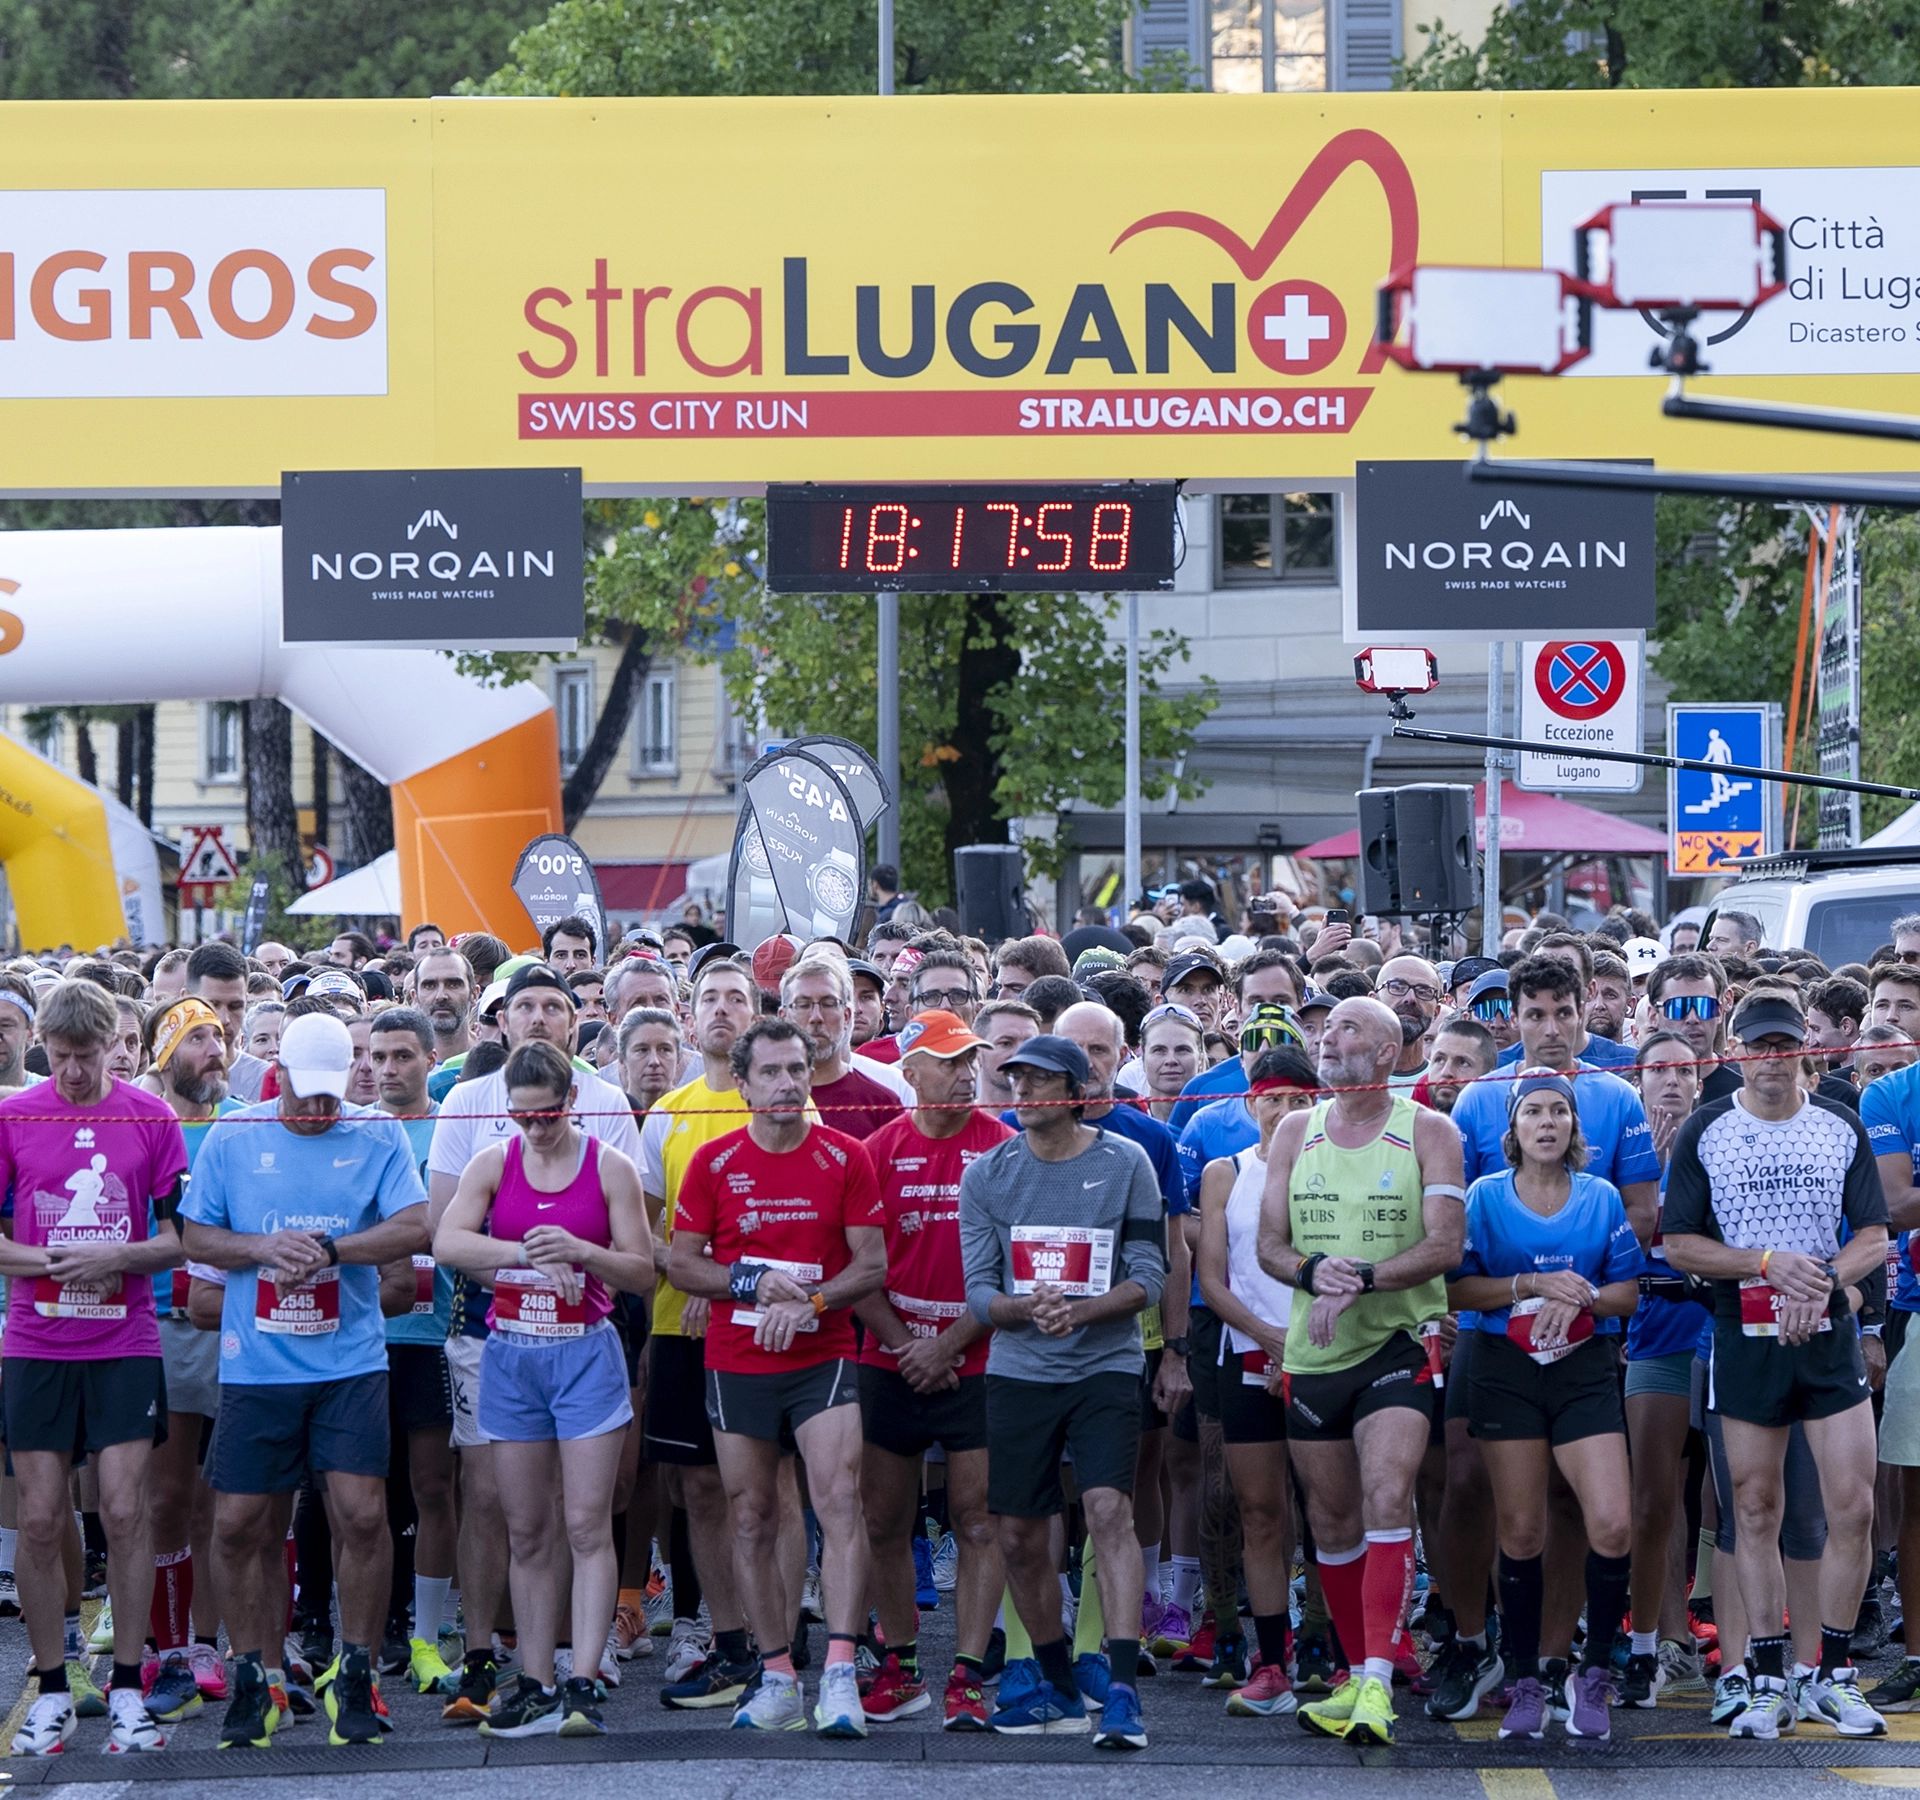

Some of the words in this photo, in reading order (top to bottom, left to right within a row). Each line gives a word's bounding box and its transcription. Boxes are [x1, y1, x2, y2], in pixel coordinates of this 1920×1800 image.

[1789, 215, 1884, 250] Città
[0, 248, 377, 341] IGROS
[1789, 265, 1824, 300] di
[1842, 267, 1920, 309] Luga
[1790, 322, 1906, 343] Dicastero
[529, 401, 637, 431] SWISS
[650, 400, 723, 431] CITY
[736, 400, 808, 430] RUN
[1019, 396, 1345, 428] STRALUGANO.CH
[840, 503, 1131, 572] 18:17:58
[1385, 541, 1626, 571] NORQAIN
[311, 550, 554, 581] NORQAIN
[1445, 581, 1477, 590] SWISS
[1481, 580, 1511, 590] MADE
[1515, 580, 1567, 589] WATCHES
[372, 591, 404, 600] SWISS
[408, 590, 438, 600] MADE
[442, 590, 495, 599] WATCHES
[1545, 724, 1614, 741] Eccezione
[1557, 764, 1601, 781] Lugano
[1744, 1163, 1820, 1178] Varese
[1738, 1176, 1826, 1194] TRIATHLON
[285, 1214, 350, 1229] MARATÓN
[1310, 1209, 1335, 1223] UBS
[1363, 1209, 1407, 1222] INEOS
[1067, 1233, 1088, 1242] 2025
[1031, 1251, 1066, 1268] 2483
[797, 1267, 817, 1278] 2025
[1034, 1267, 1061, 1281] AMIN
[279, 1294, 315, 1309] 2545
[521, 1294, 556, 1310] 2468
[76, 1306, 121, 1317] MIGROS
[270, 1308, 324, 1321] DOMENICO
[519, 1308, 558, 1323] VALERIE
[939, 1307, 961, 1316] 2025
[294, 1321, 336, 1333] MIGROS
[535, 1325, 580, 1336] MIGROS
